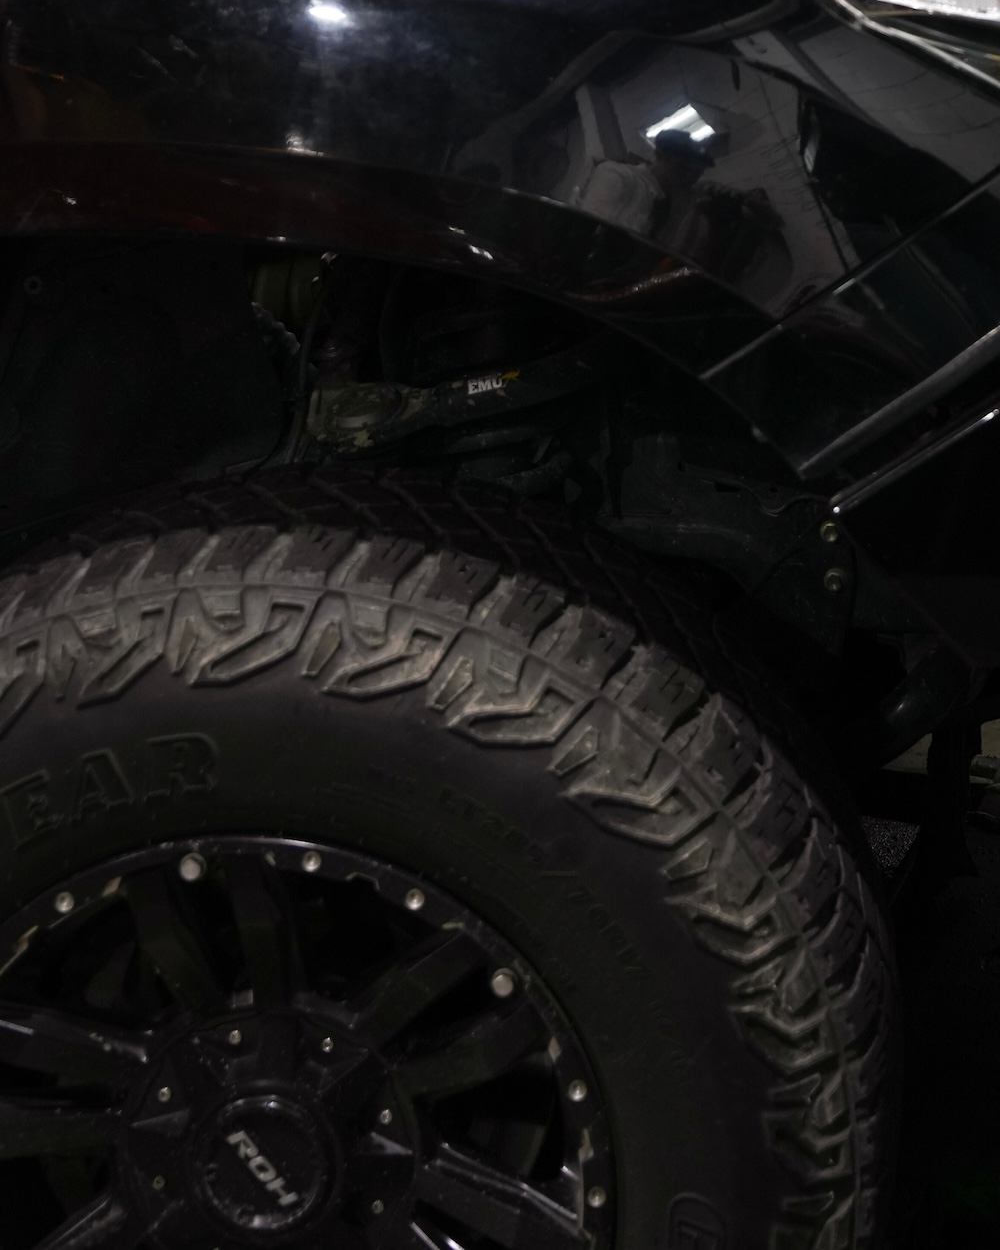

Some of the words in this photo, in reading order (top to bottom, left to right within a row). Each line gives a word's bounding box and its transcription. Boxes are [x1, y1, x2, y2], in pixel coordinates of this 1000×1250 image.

[468, 378, 503, 395] EMU
[0, 731, 220, 852] EAR
[226, 1130, 299, 1206] ROH
